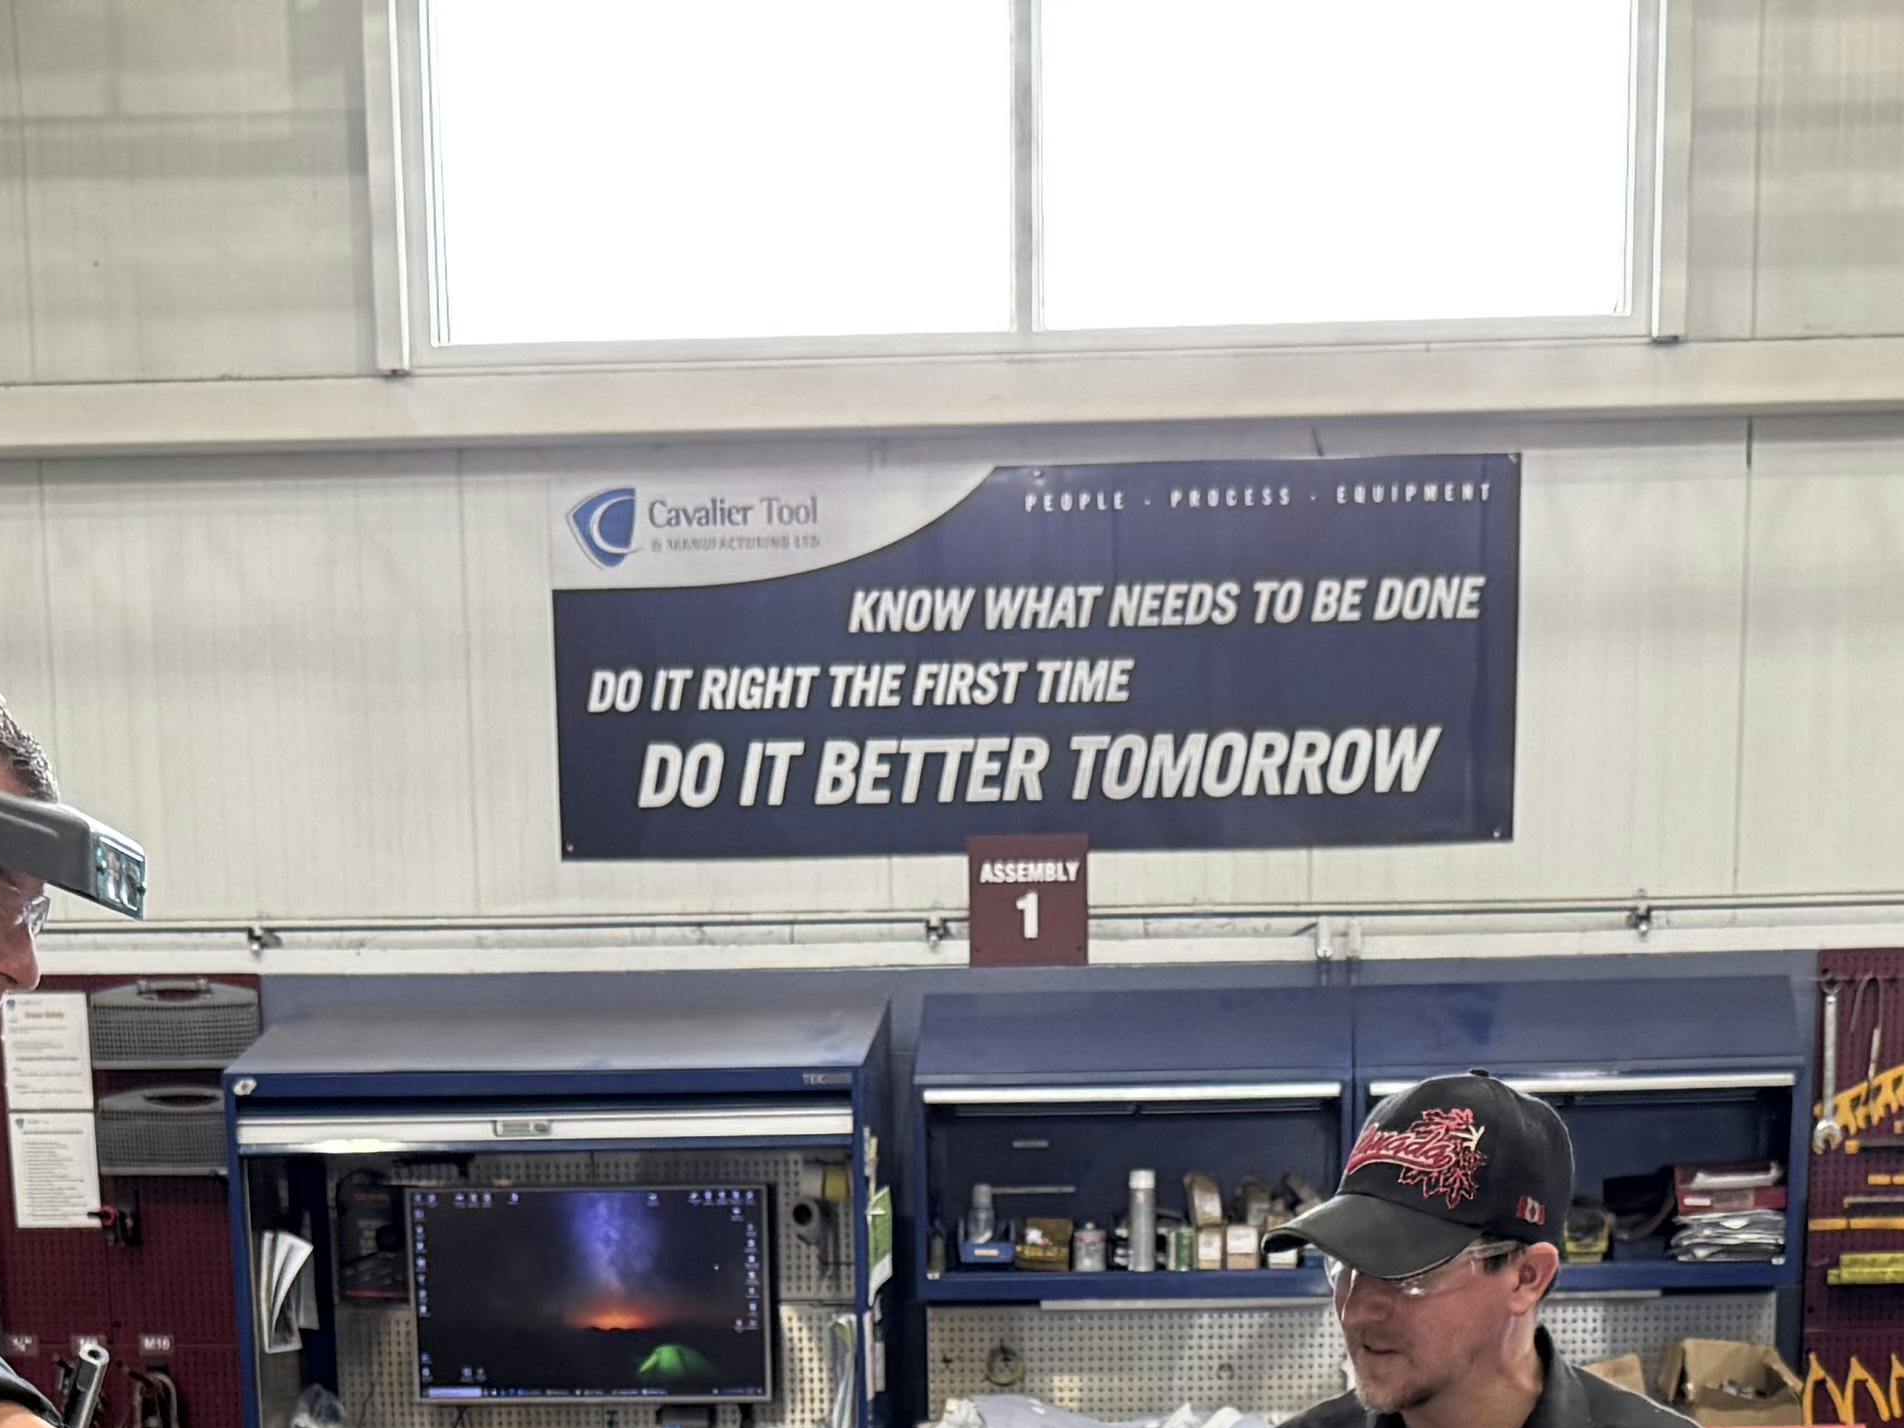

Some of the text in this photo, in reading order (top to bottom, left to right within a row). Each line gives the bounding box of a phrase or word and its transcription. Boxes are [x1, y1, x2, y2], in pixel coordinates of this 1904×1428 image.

[648, 495, 818, 528] Cavalier Tool
[1024, 481, 1492, 513] PEOPLE PROCESS EQUIPMENT
[849, 576, 1485, 632] KNOW WHAT NEEDS TO BE DONE
[589, 659, 1134, 712] DO IT RIGHT THE FIRST TIME
[639, 727, 1441, 807] DO IT BETTER TOMORROW
[979, 859, 1080, 886] ASSEMBLY
[1015, 890, 1040, 940] 1
